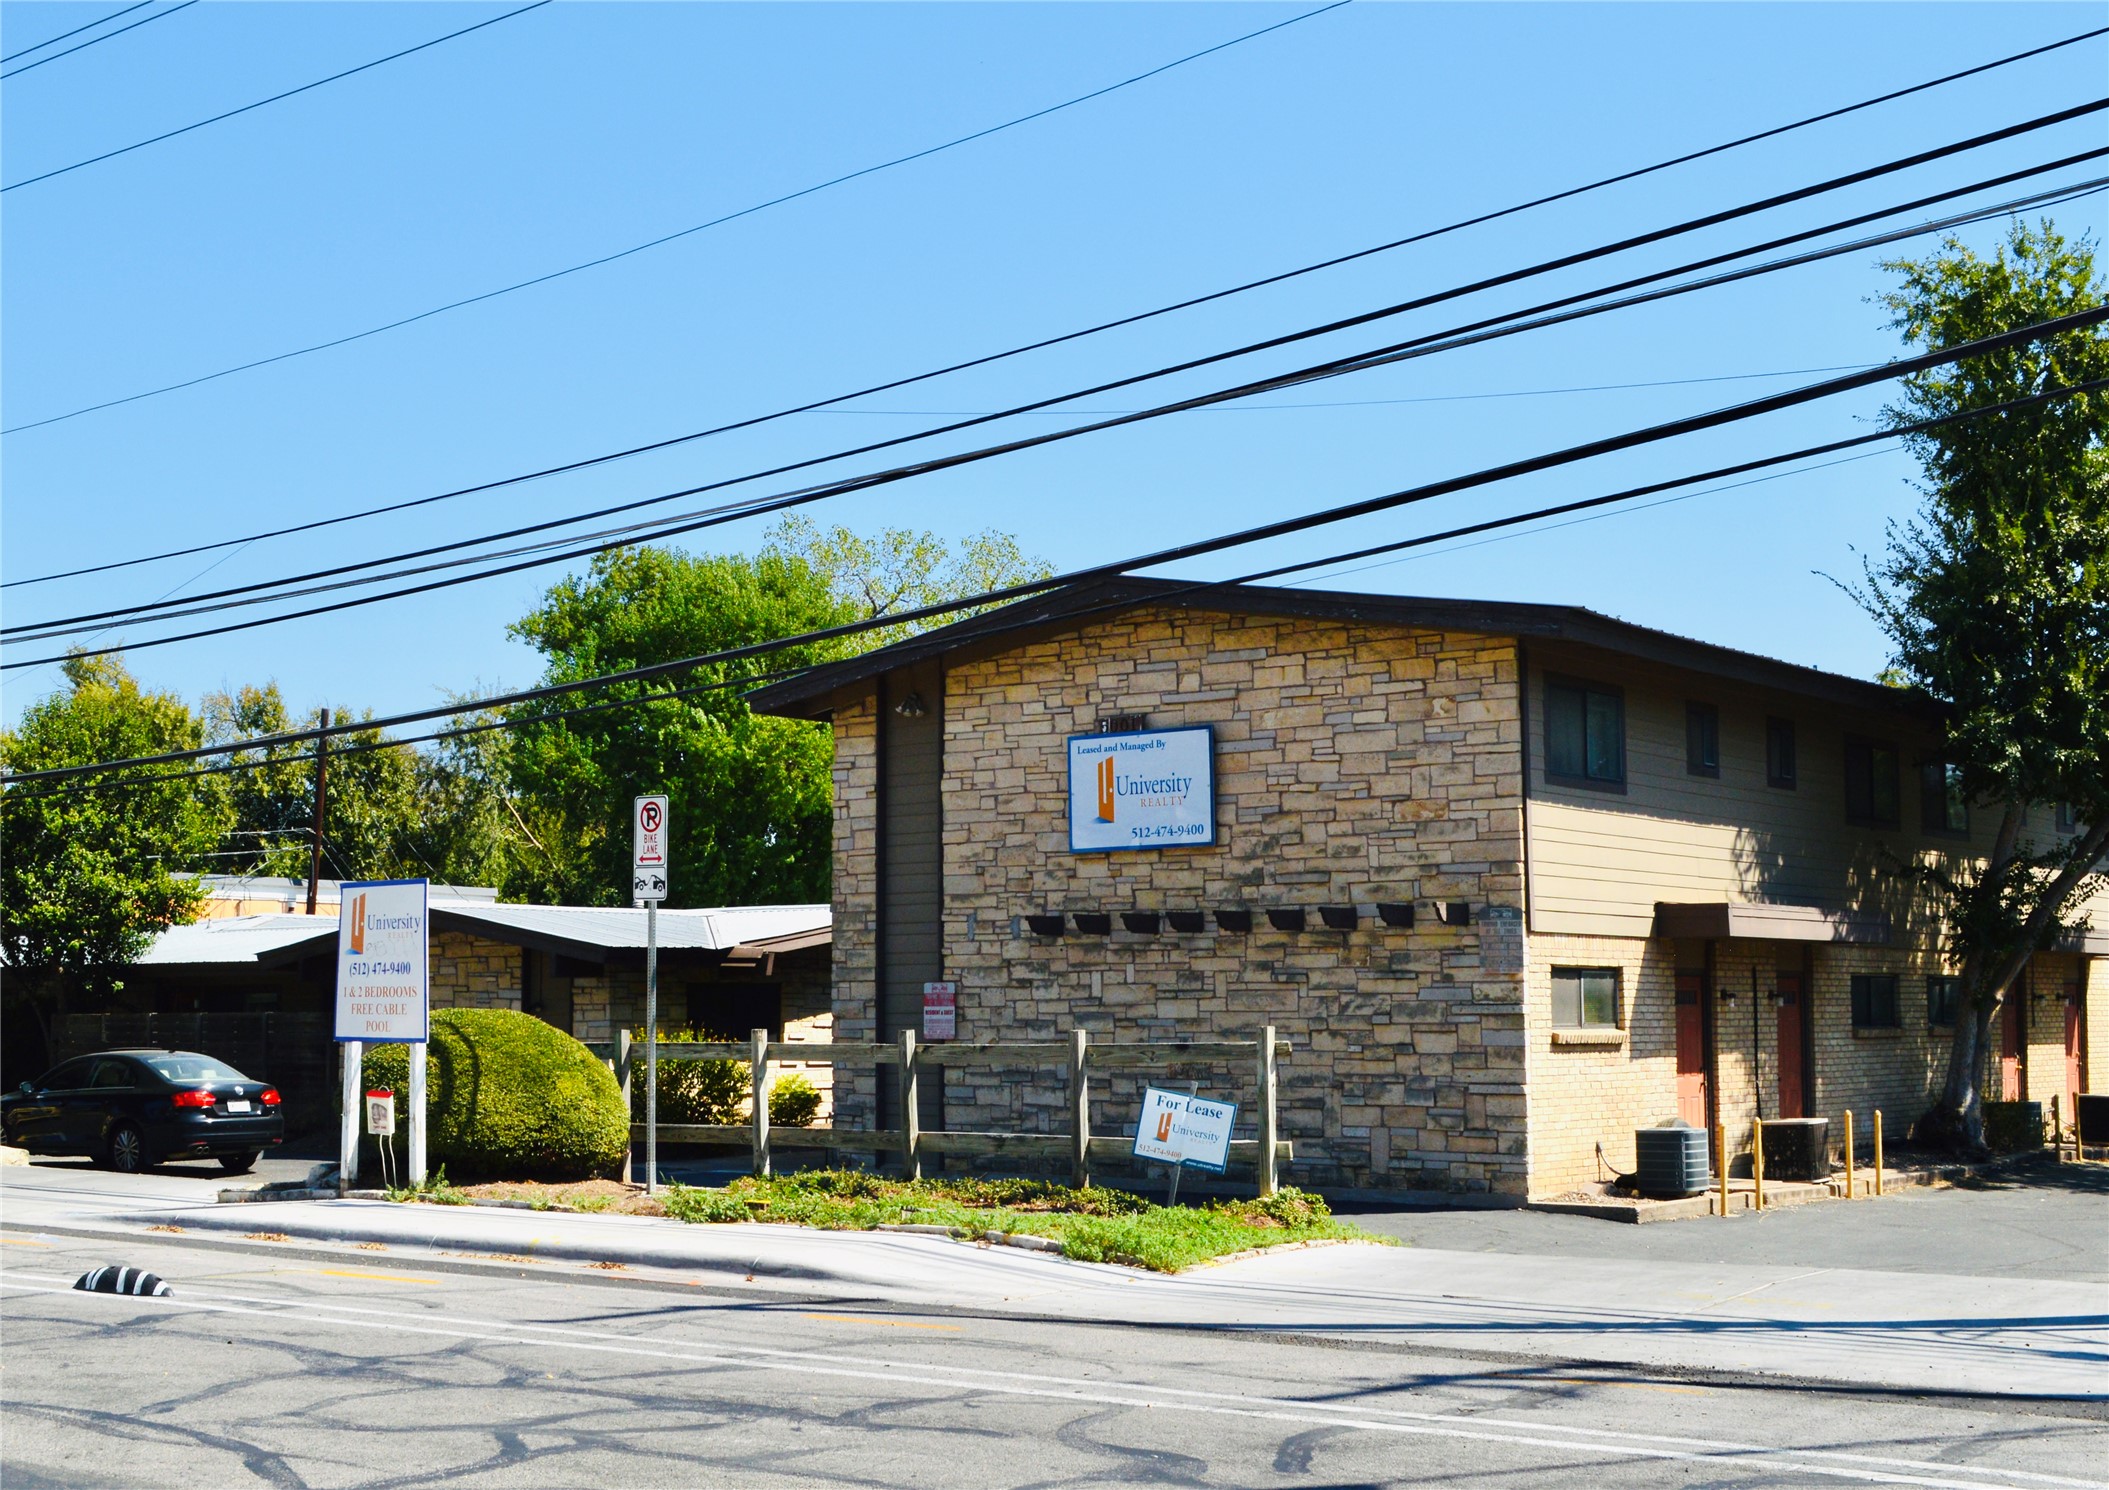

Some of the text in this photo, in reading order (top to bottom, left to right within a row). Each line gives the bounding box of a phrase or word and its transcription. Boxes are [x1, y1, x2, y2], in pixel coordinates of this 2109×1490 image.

[1077, 740, 1167, 755] Leased and Managed By
[1116, 772, 1193, 799] University
[1140, 796, 1185, 808] REALTY
[1132, 823, 1204, 839] 512-474-9400
[644, 834, 657, 844] BIKE
[643, 845, 658, 854] LANE
[367, 913, 421, 933] University
[349, 961, 411, 979] (512) 474-9400
[349, 987, 356, 998] &
[358, 987, 363, 998] 2
[364, 986, 418, 998] BEDROOMS
[351, 1003, 408, 1016] FREE CABLE
[366, 1021, 391, 1033] POOL
[1156, 1094, 1223, 1119] For Lease
[1173, 1124, 1220, 1144] University
[1138, 1143, 1182, 1159] 512-474-9400
